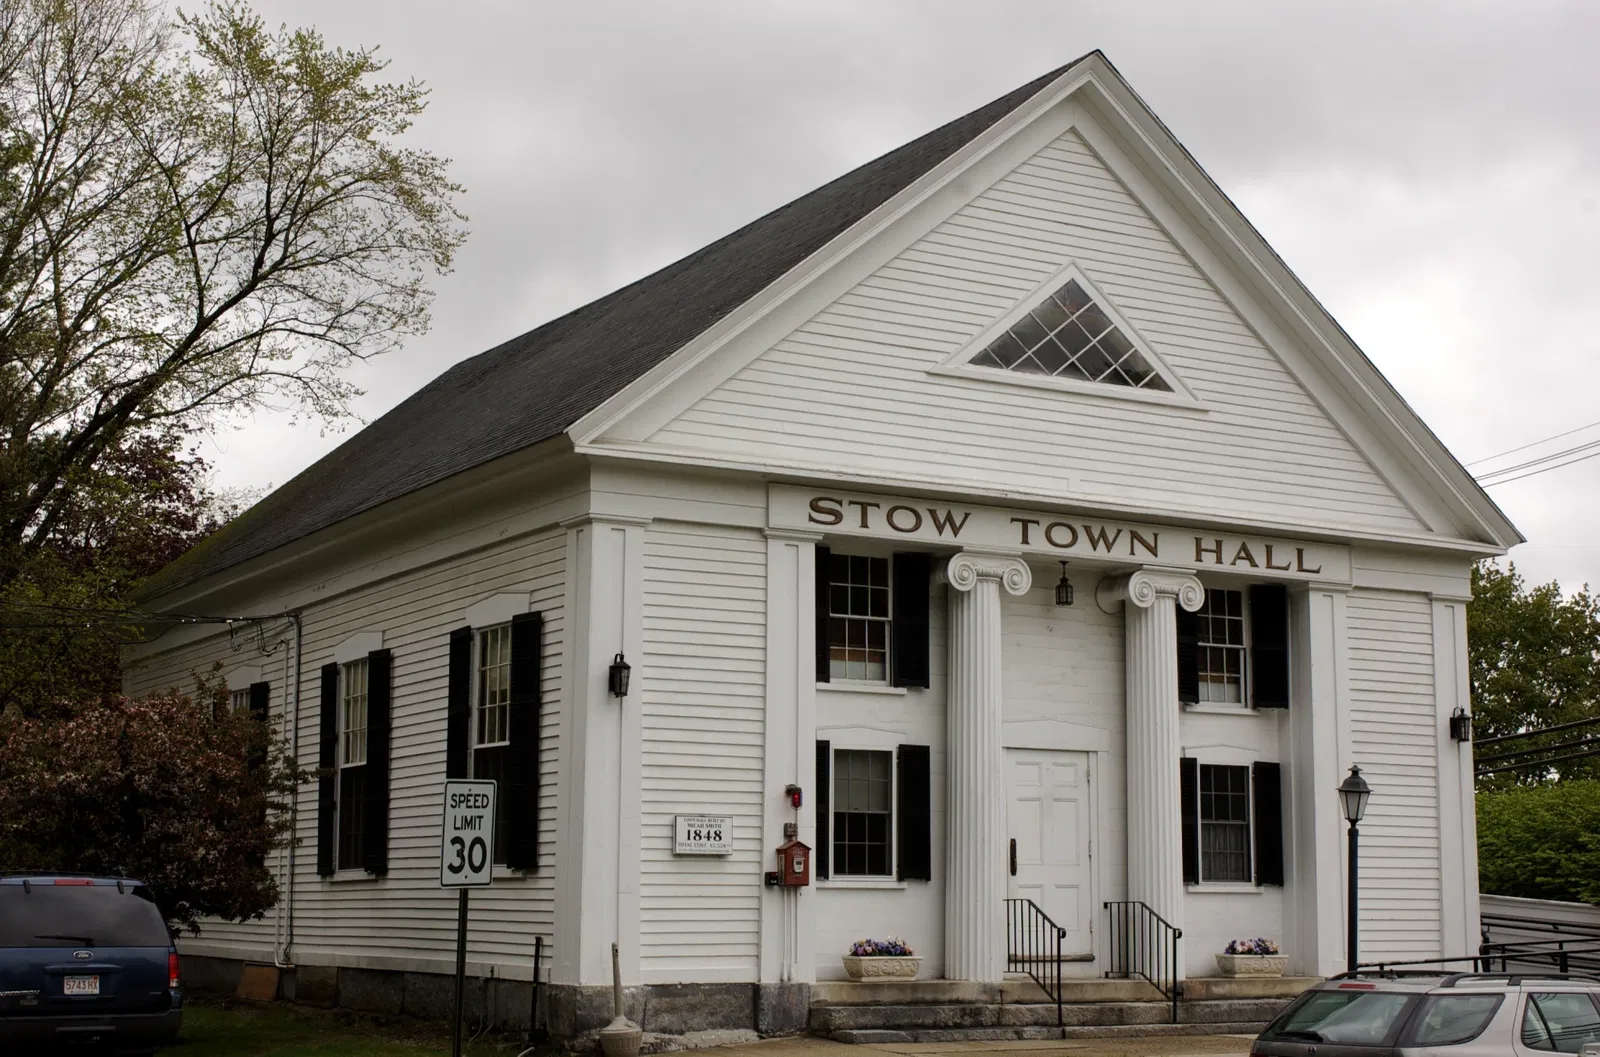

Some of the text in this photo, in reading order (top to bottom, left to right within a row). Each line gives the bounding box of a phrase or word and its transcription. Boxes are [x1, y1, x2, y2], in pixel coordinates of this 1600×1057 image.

[808, 496, 1322, 573] STOW TOWN HALL
[450, 793, 489, 809] SPEED
[453, 815, 484, 830] LIMIT
[687, 829, 722, 842] 1848
[447, 836, 487, 874] 30
[65, 980, 98, 990] 5743 HX
